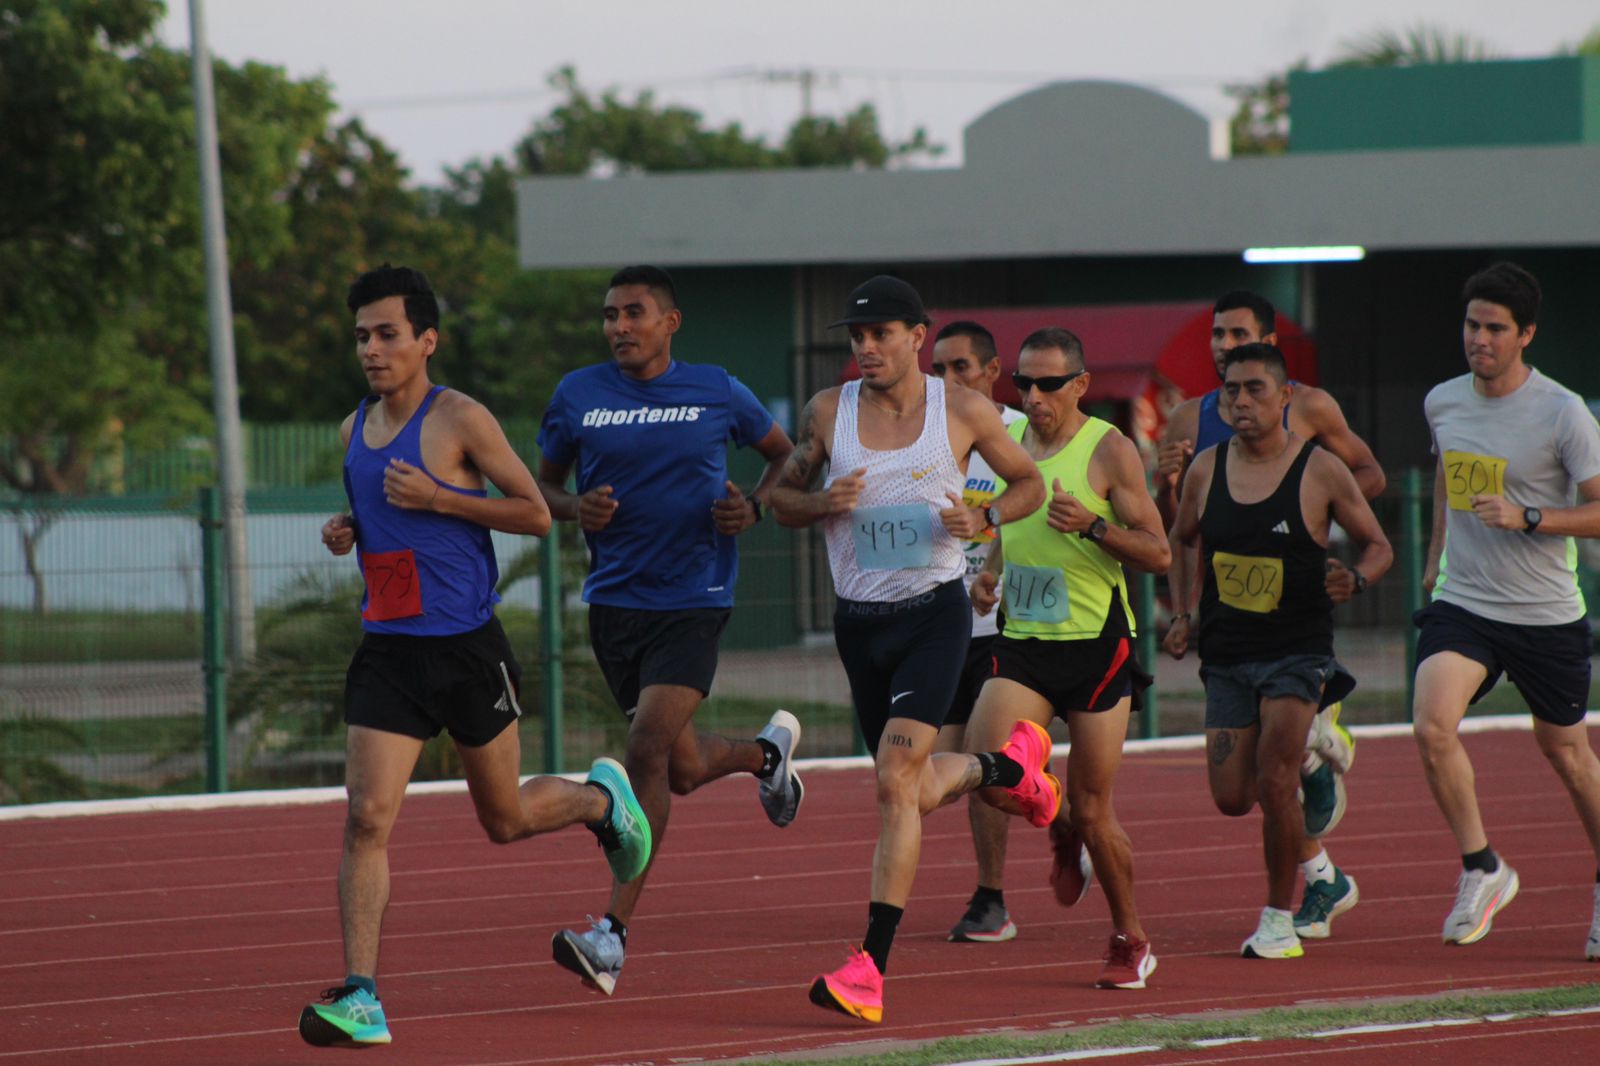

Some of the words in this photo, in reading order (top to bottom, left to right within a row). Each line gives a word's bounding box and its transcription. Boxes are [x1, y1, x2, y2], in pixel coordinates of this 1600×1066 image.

[1447, 460, 1498, 495] 301
[861, 519, 918, 551] 495
[1008, 569, 1057, 609] 416
[1220, 564, 1278, 598] 302
[848, 602, 891, 615] NIKE
[894, 591, 936, 614] PRO
